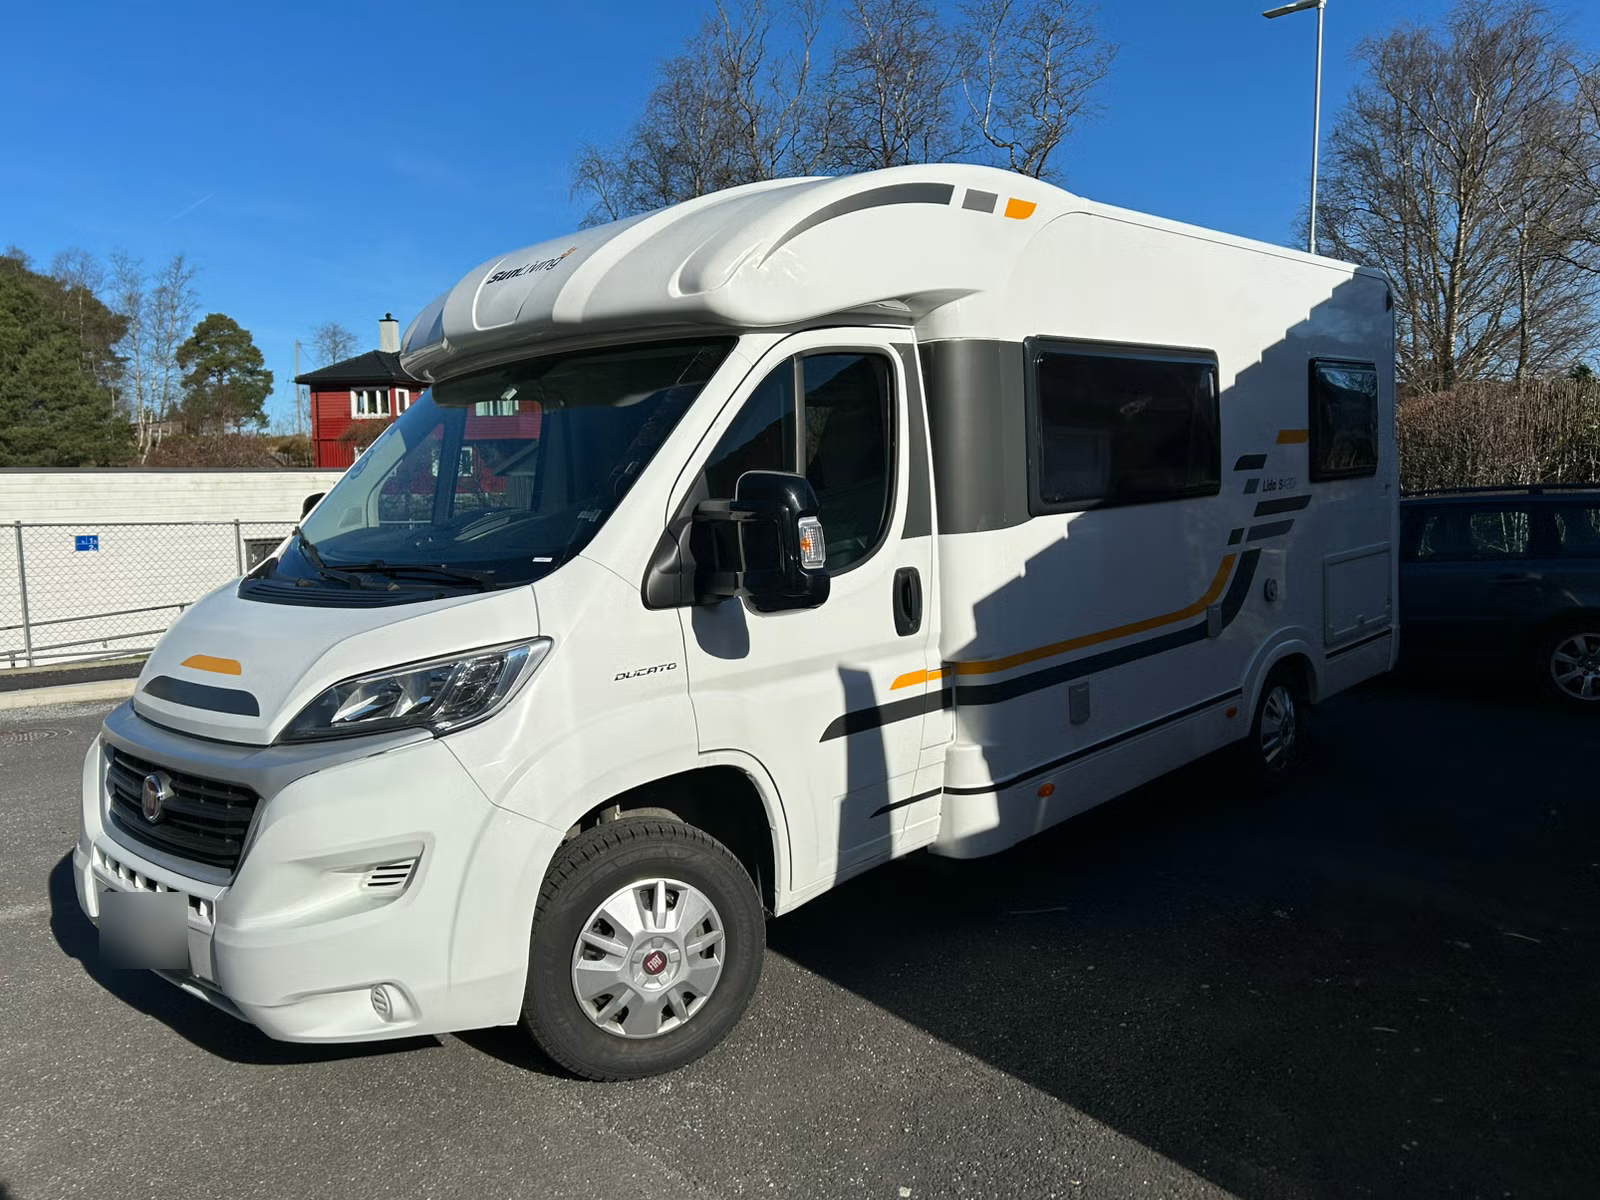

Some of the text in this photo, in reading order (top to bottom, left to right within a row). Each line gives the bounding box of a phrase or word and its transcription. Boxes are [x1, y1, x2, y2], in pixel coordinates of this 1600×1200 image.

[1262, 479, 1276, 493] Lido
[614, 662, 677, 681] DUCATO
[647, 954, 663, 972] FIAT
